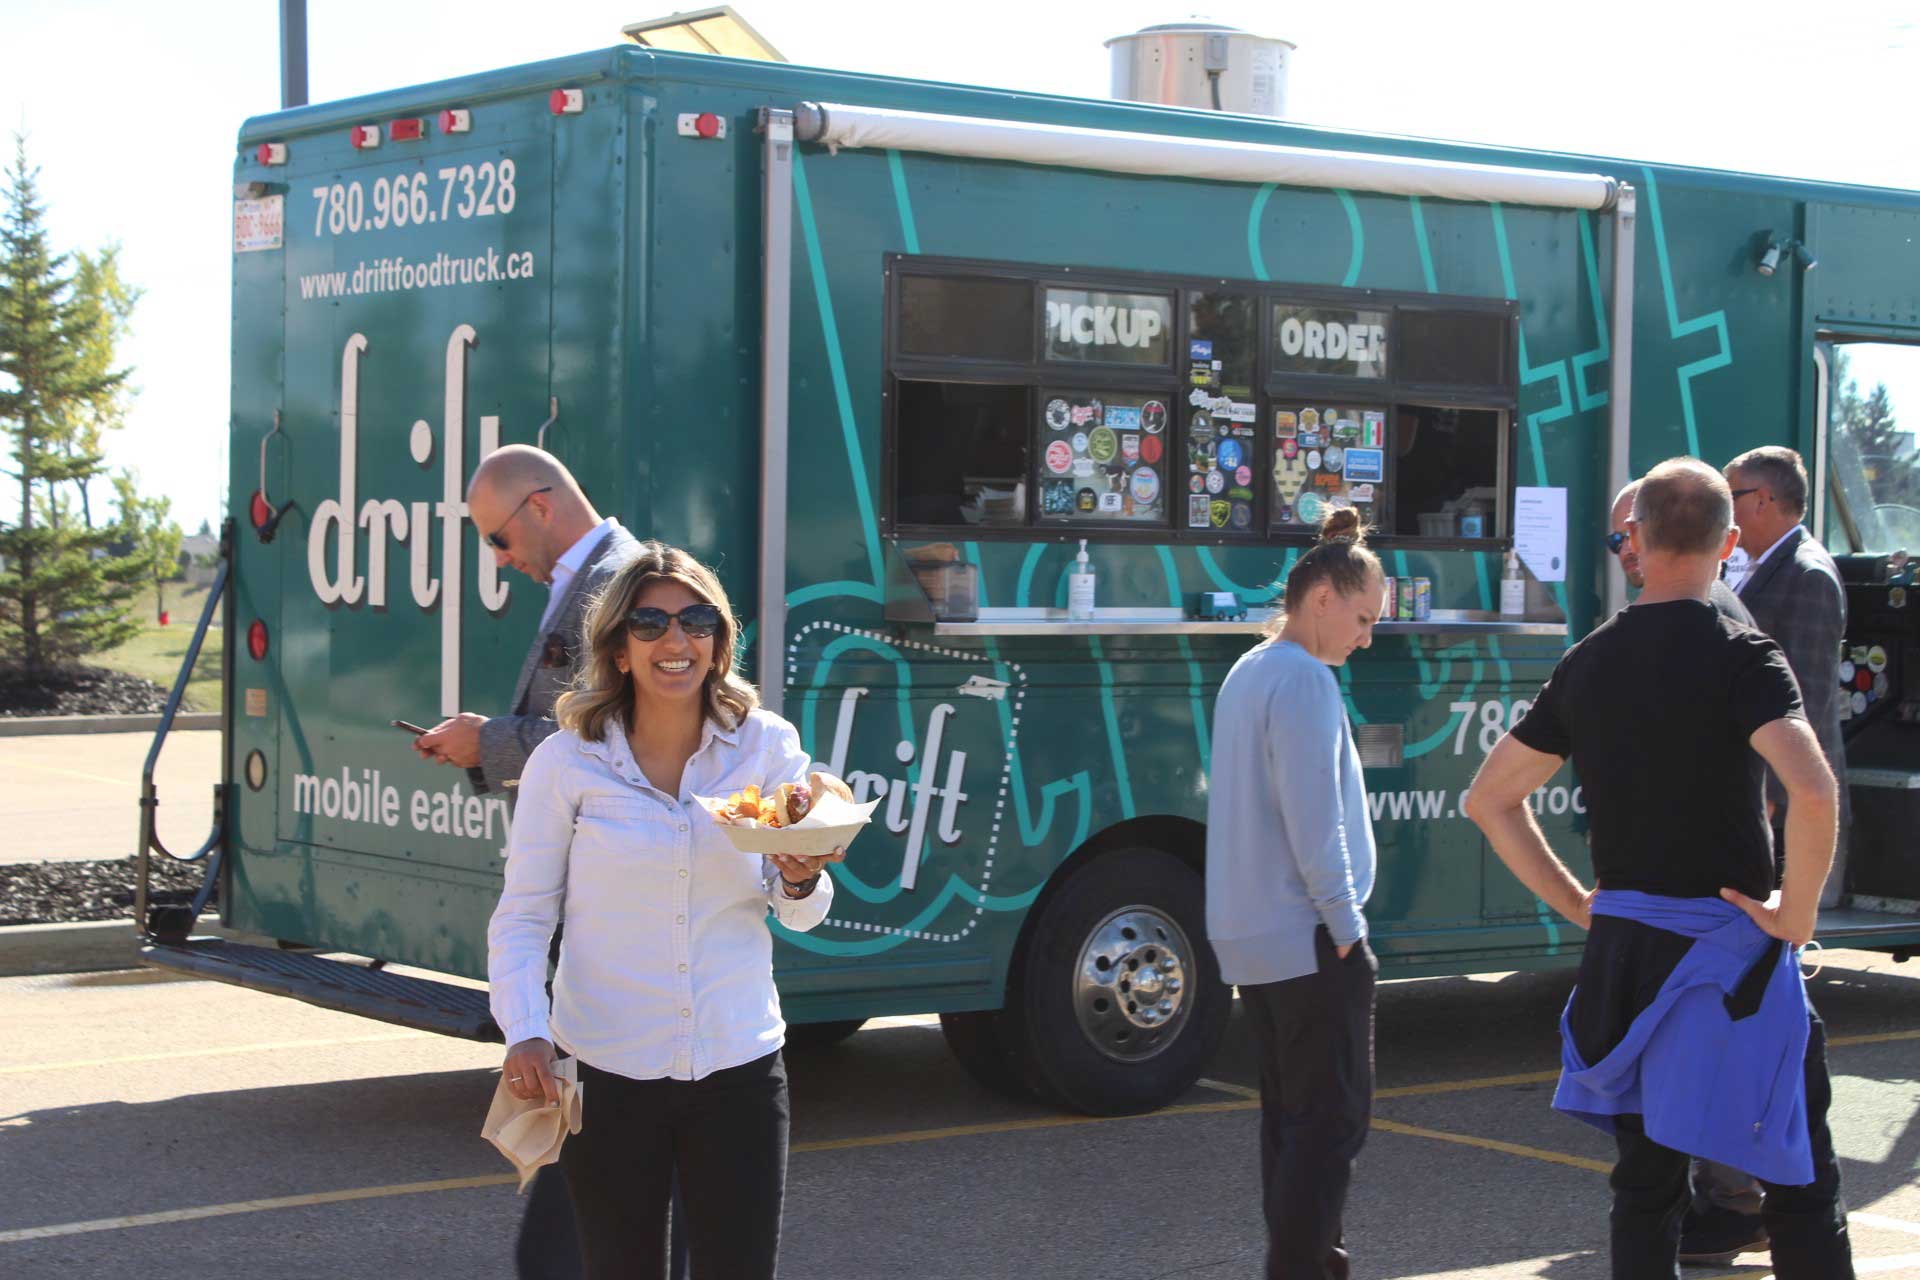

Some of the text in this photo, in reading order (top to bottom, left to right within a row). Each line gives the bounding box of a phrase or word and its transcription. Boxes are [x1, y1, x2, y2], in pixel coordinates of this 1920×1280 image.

[312, 158, 517, 237] 780.966.7328
[300, 247, 534, 299] www.driftfoodtruck.ca
[1046, 301, 1161, 348] PICKUP
[1280, 317, 1387, 362] ORDER
[307, 323, 510, 718] drift
[293, 766, 400, 827] mobile
